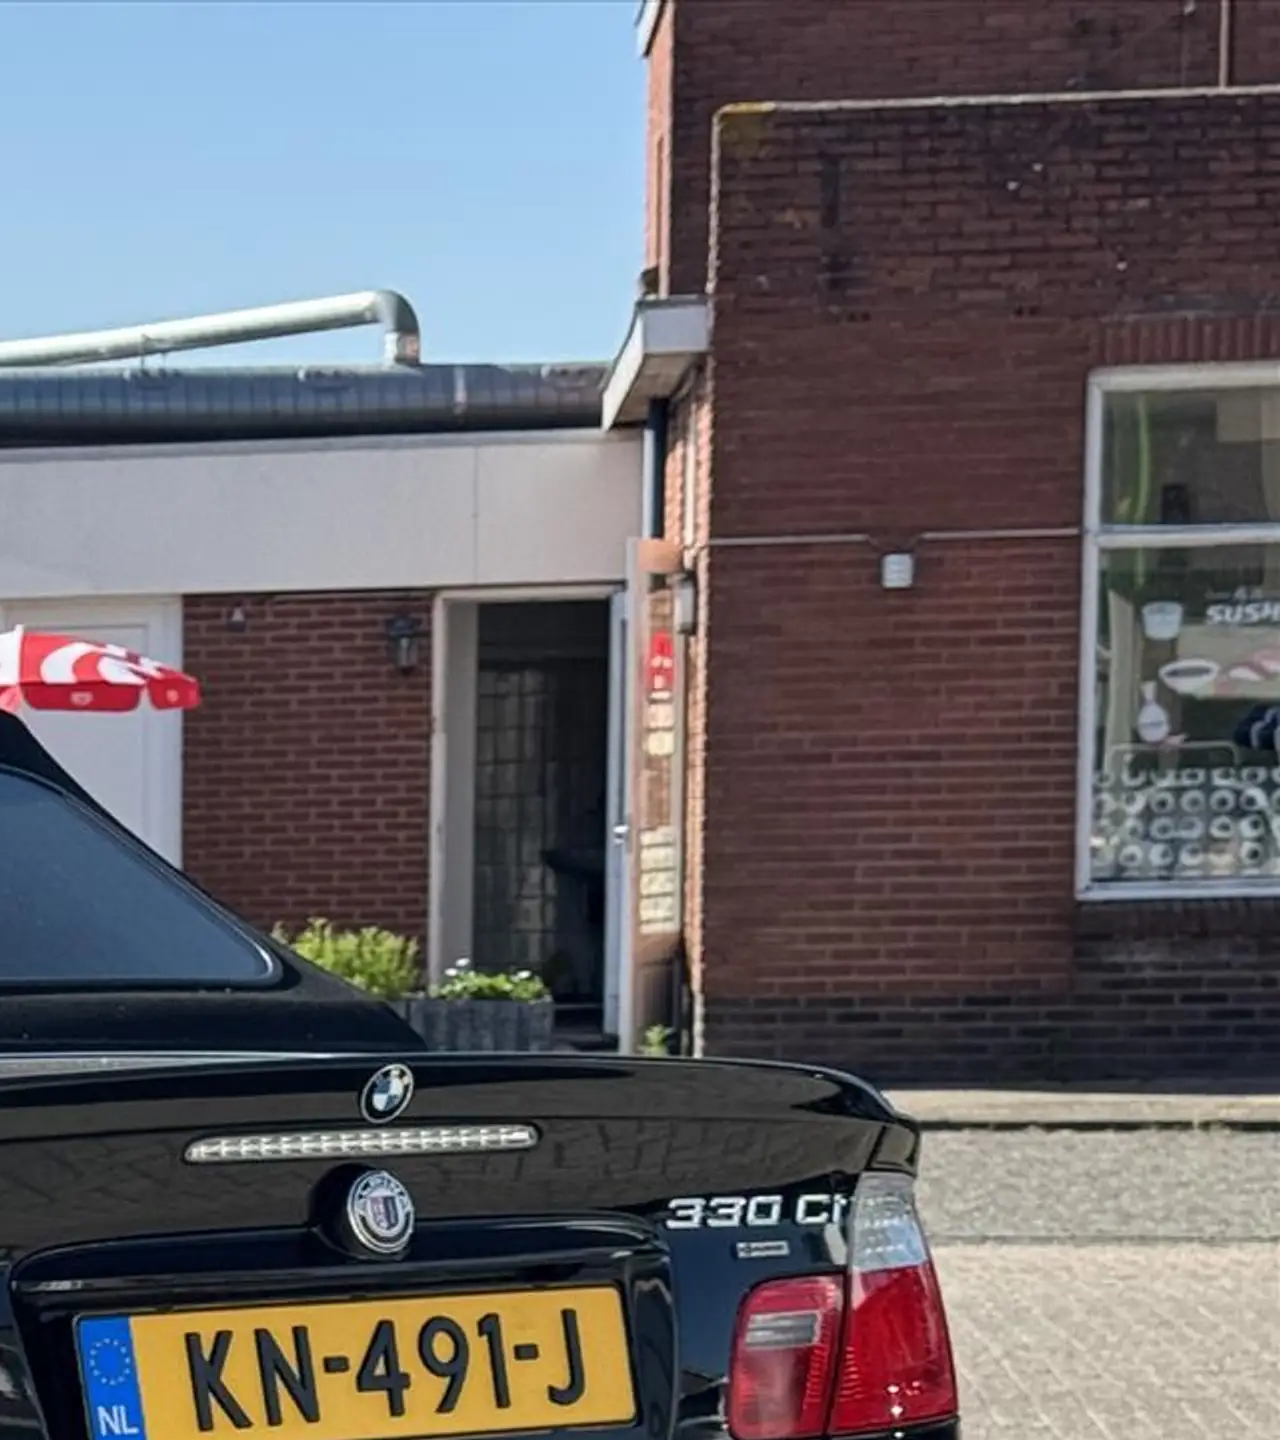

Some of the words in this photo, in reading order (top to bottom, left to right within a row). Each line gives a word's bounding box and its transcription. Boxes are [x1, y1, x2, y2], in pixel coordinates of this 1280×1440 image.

[665, 1194, 784, 1229] 330
[184, 1308, 588, 1432] KN-491-J
[96, 1405, 139, 1438] NL
